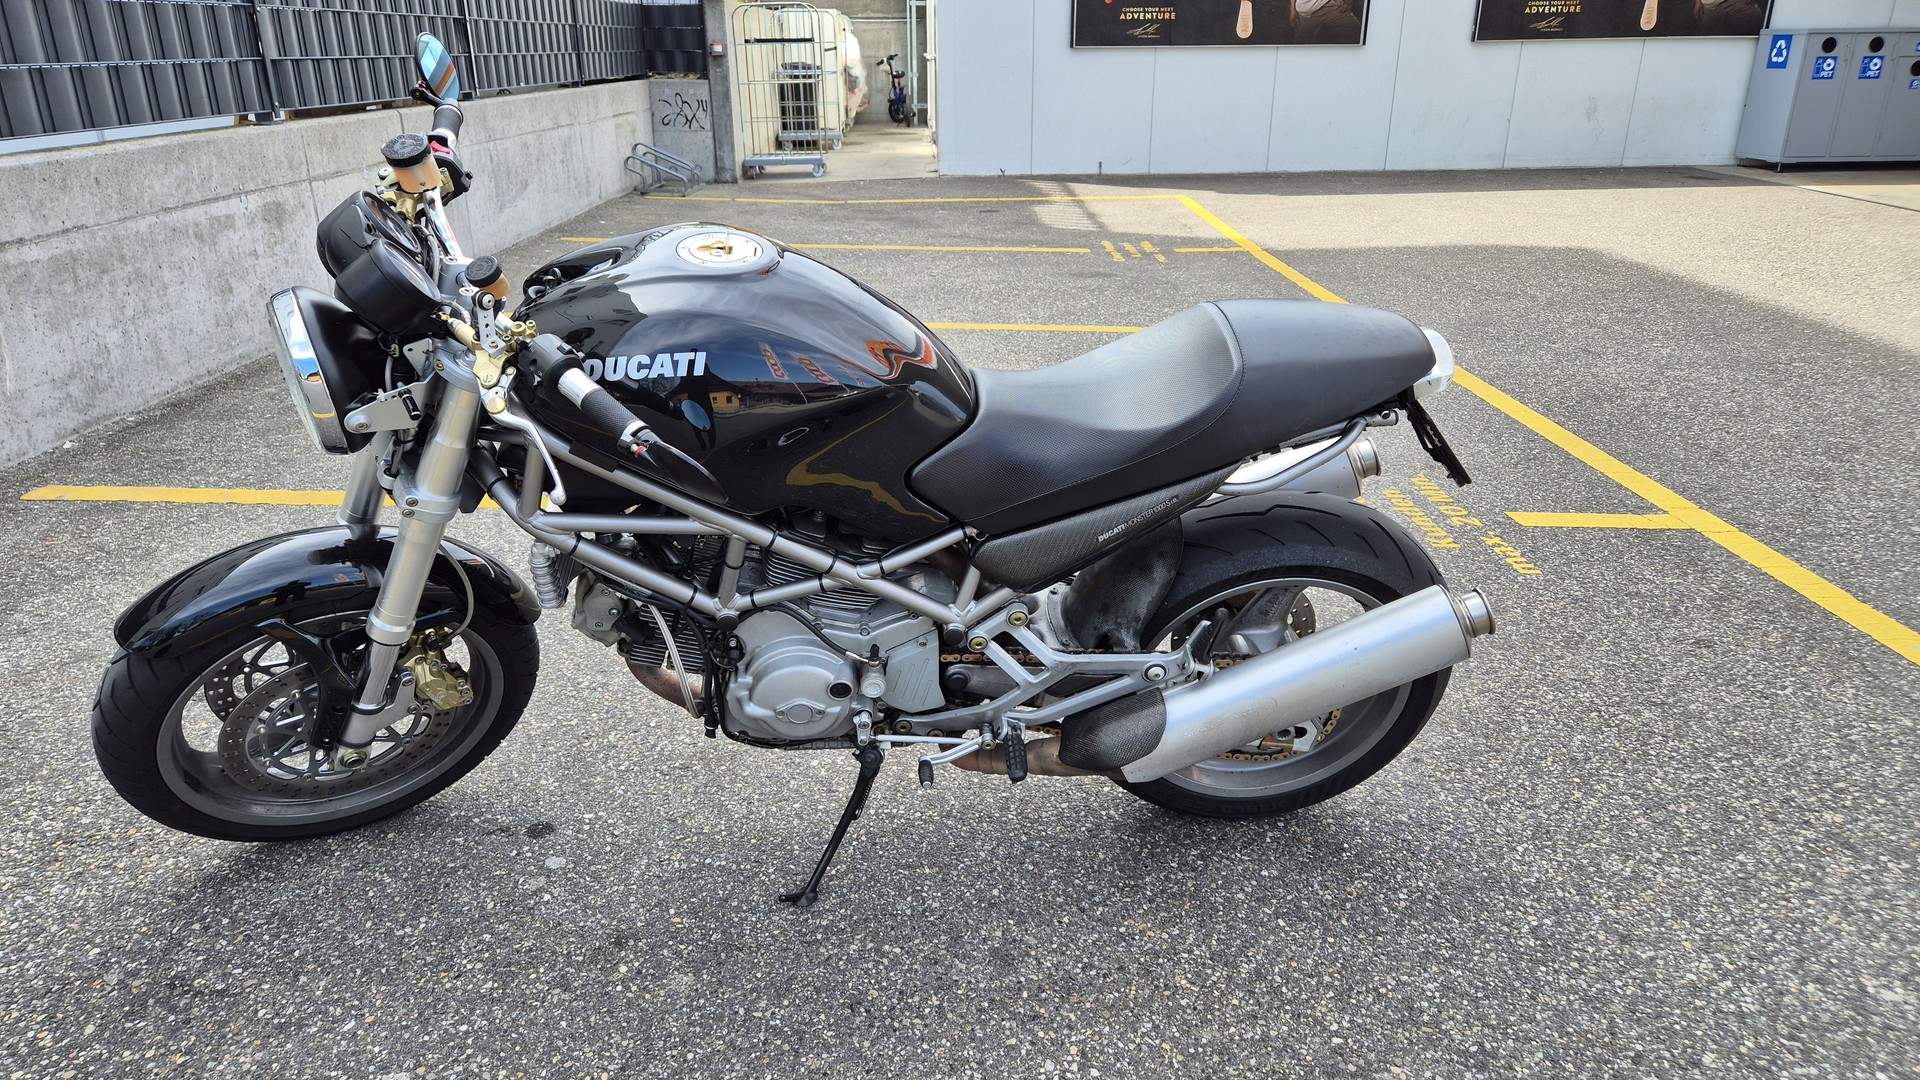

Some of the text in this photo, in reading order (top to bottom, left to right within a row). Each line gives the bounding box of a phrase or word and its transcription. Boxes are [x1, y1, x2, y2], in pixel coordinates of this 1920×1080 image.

[1120, 12, 1176, 20] ADVENTURE
[1525, 5, 1582, 14] ADVENTURE
[582, 351, 707, 382] DUCATI
[1382, 489, 1462, 549] Kunden
[1438, 505, 1484, 527] 20
[1479, 530, 1543, 575] max.
